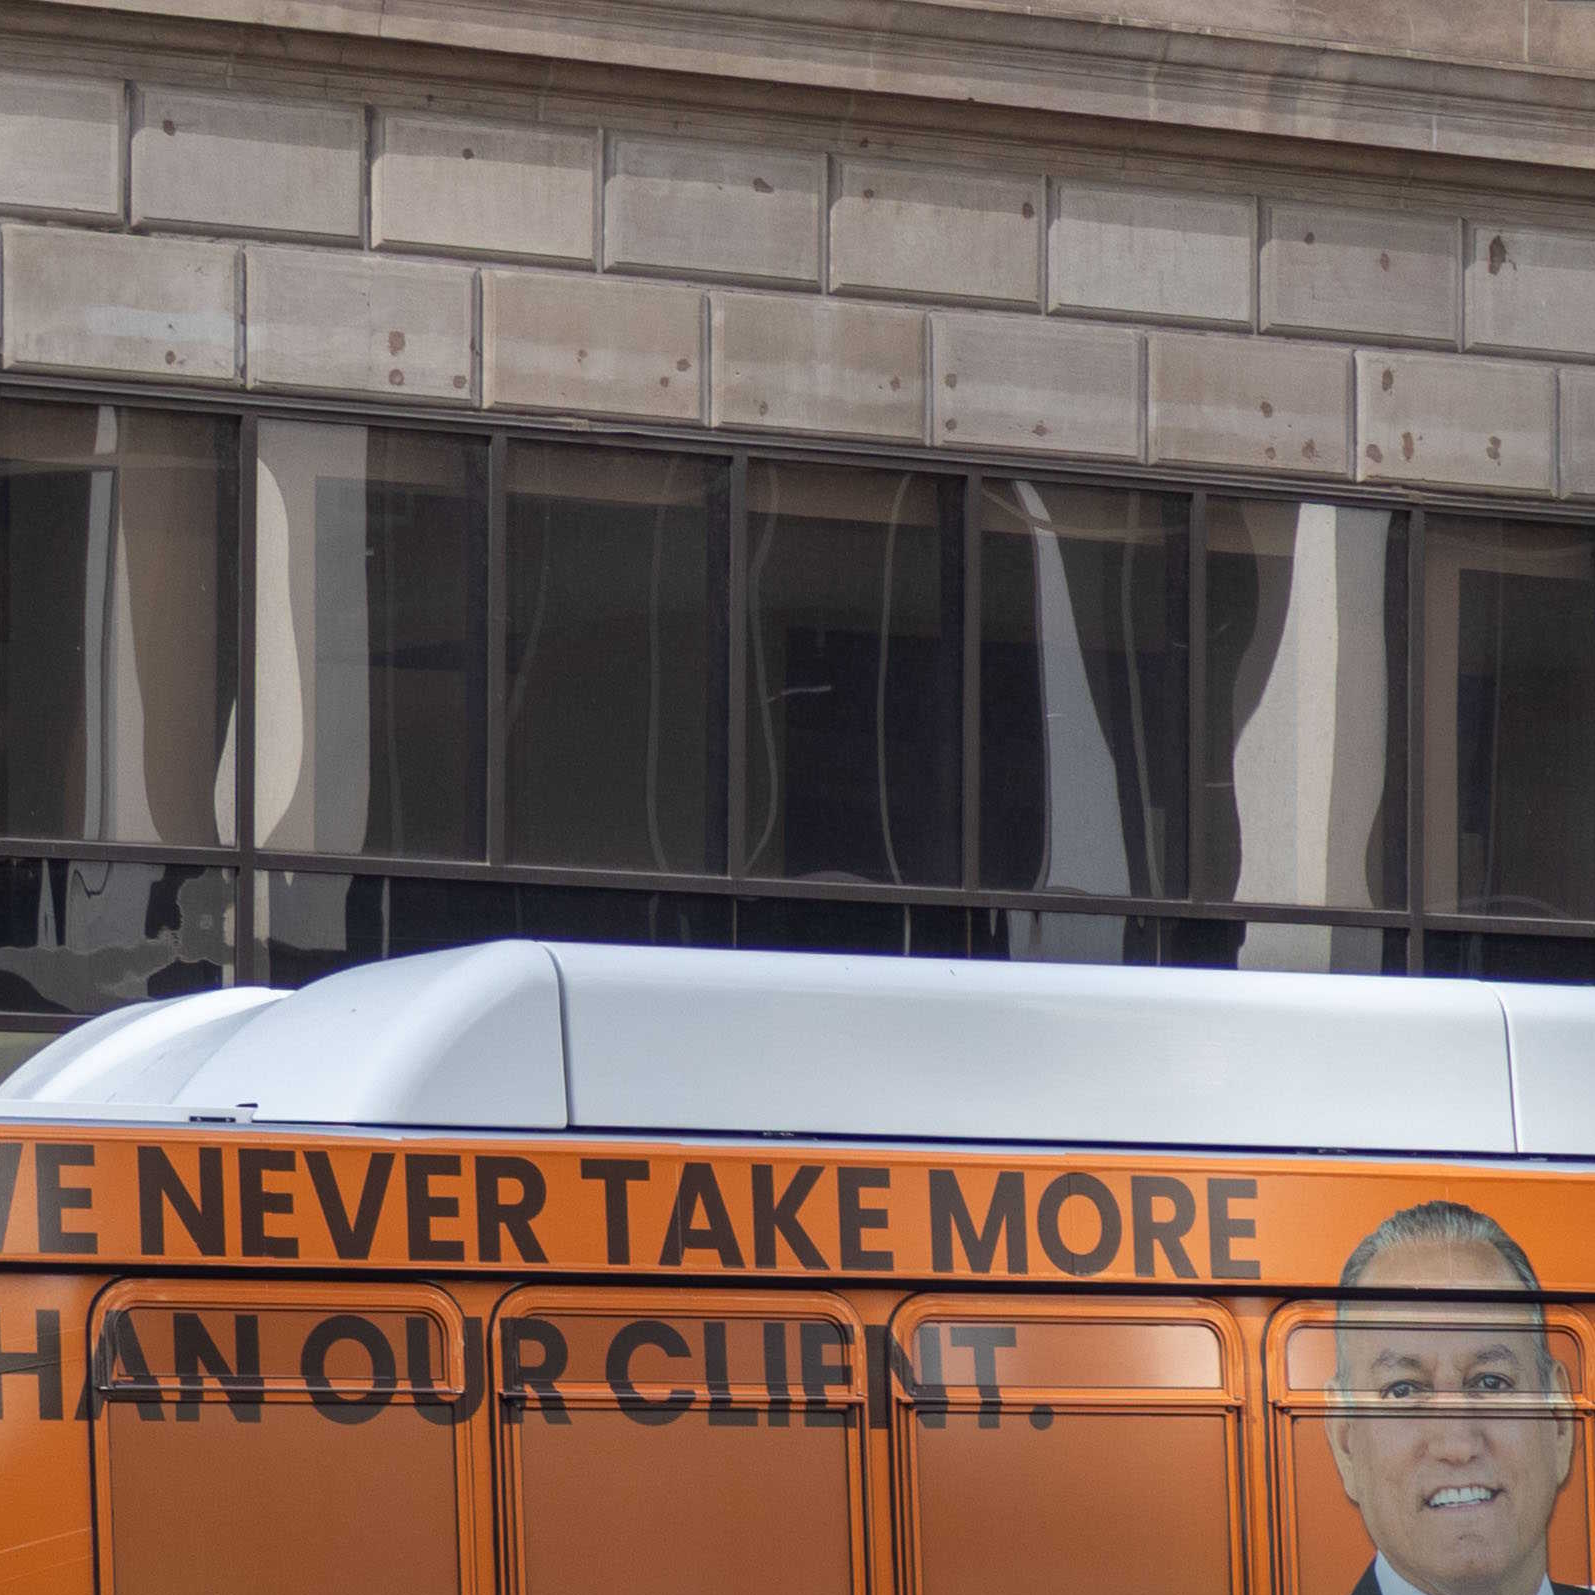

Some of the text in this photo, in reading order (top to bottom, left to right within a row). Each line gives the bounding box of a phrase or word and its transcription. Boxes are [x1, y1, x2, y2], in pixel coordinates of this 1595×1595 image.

[137, 1145, 550, 1264] NEVER
[580, 1158, 895, 1272] TAKE
[928, 1168, 1262, 1280] MORE
[300, 1313, 573, 1426] OUR
[604, 1319, 1055, 1432] CLIENT.
